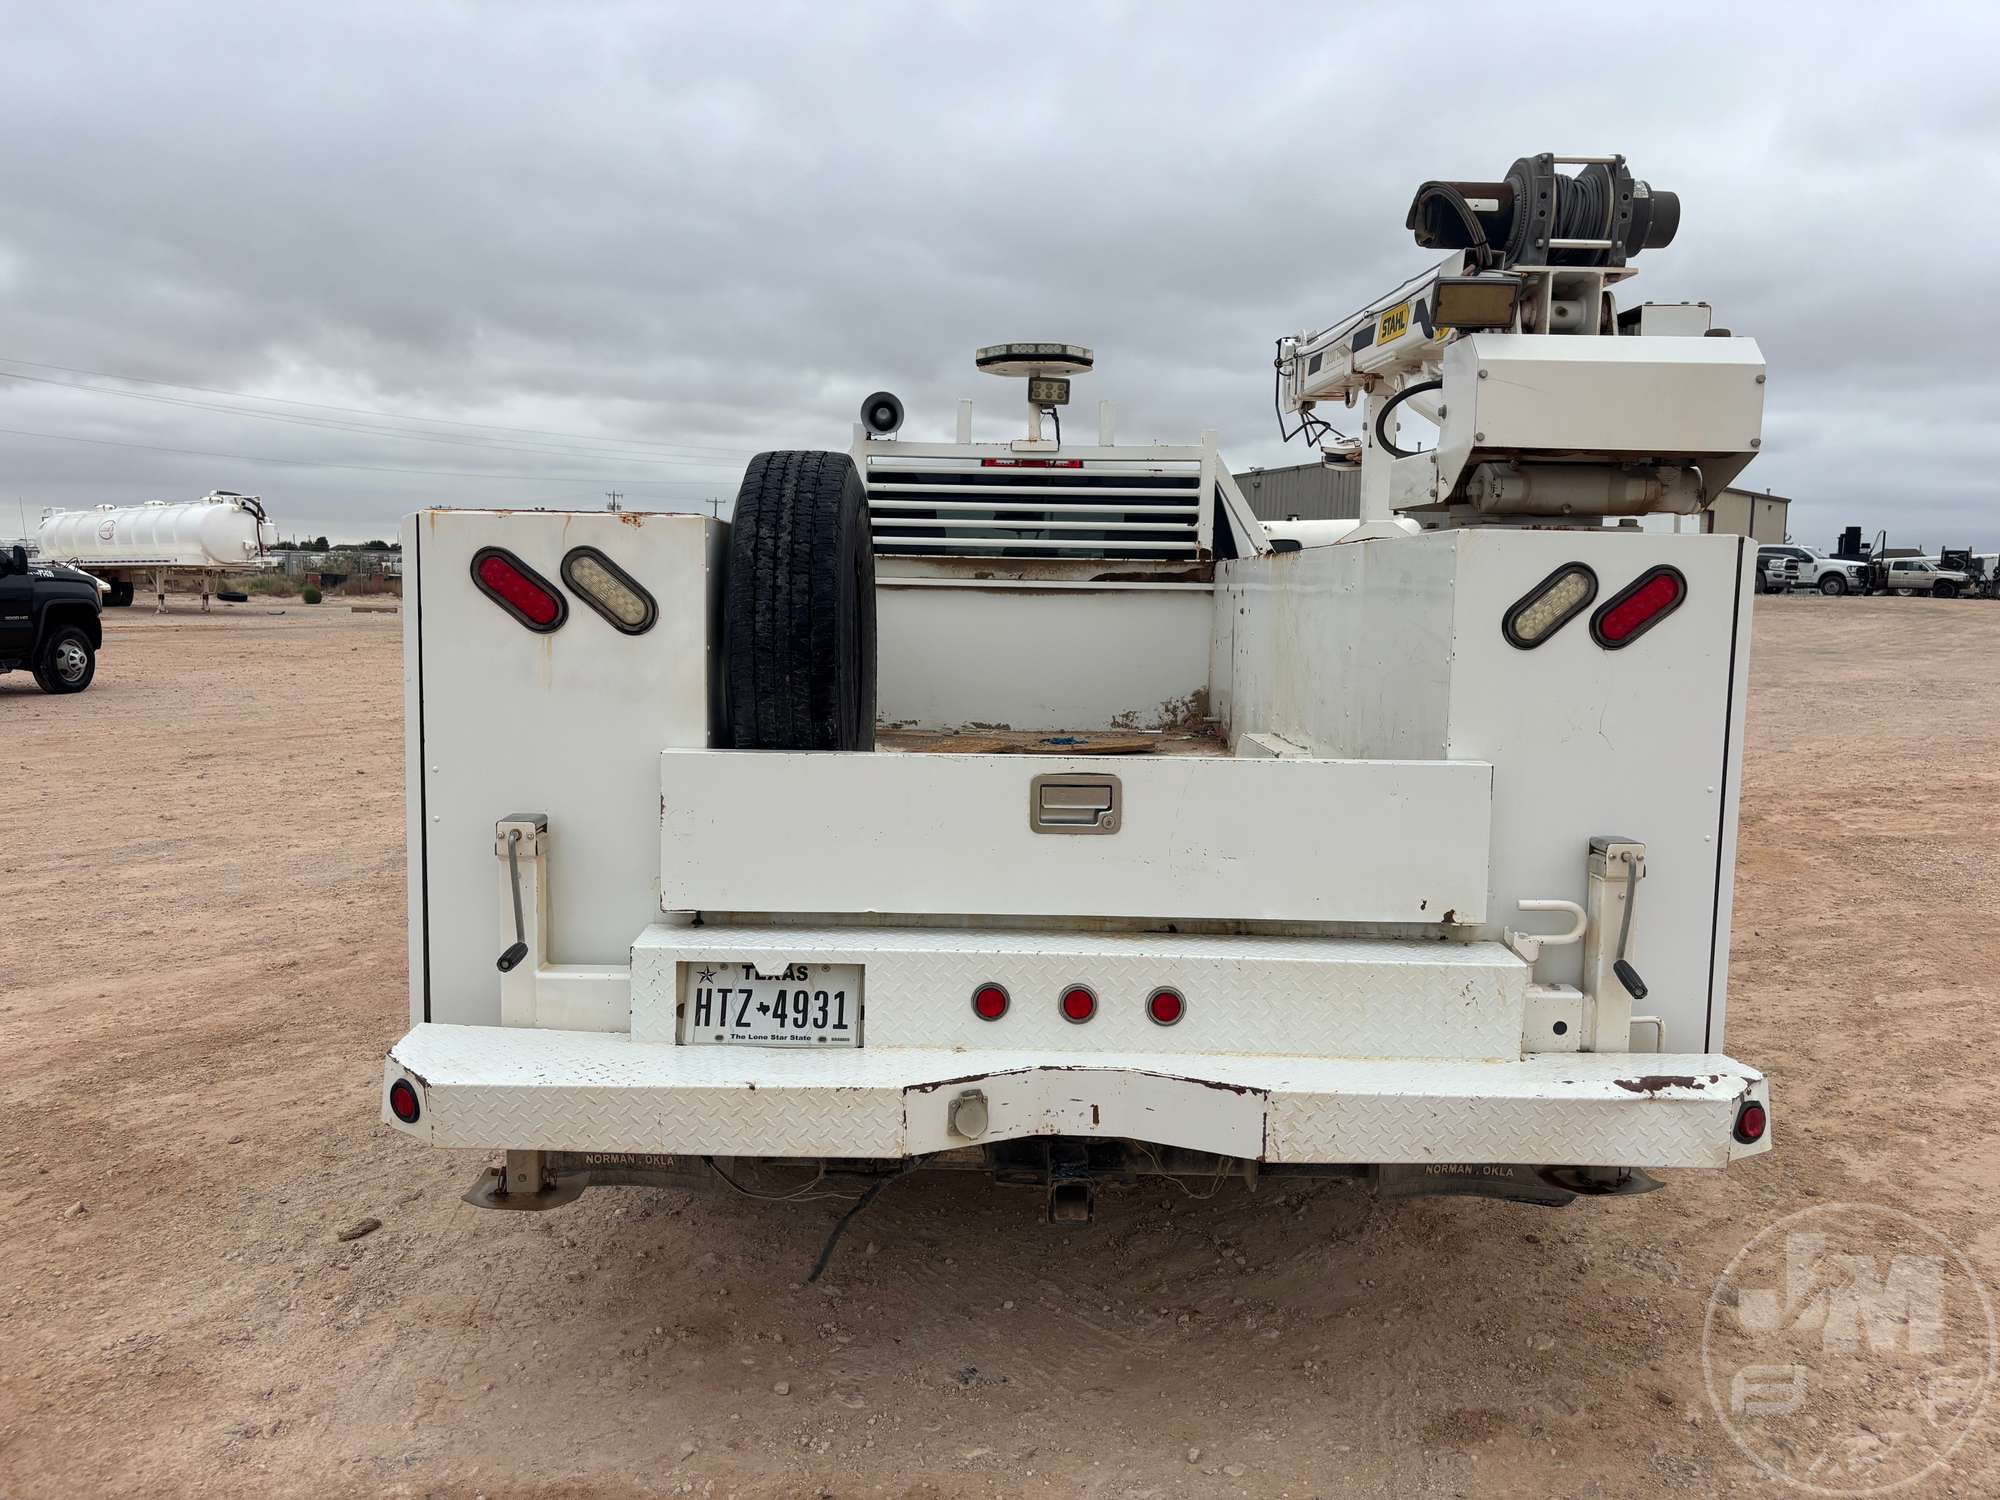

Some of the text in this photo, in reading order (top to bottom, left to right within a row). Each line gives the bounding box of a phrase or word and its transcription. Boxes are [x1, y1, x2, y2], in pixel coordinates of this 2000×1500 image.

[1381, 310, 1405, 338] STAHL
[742, 964, 808, 981] TAS
[695, 988, 848, 1030] HTZ 4931
[645, 1154, 674, 1166] OKLA
[1482, 1166, 1514, 1177] OKLA
